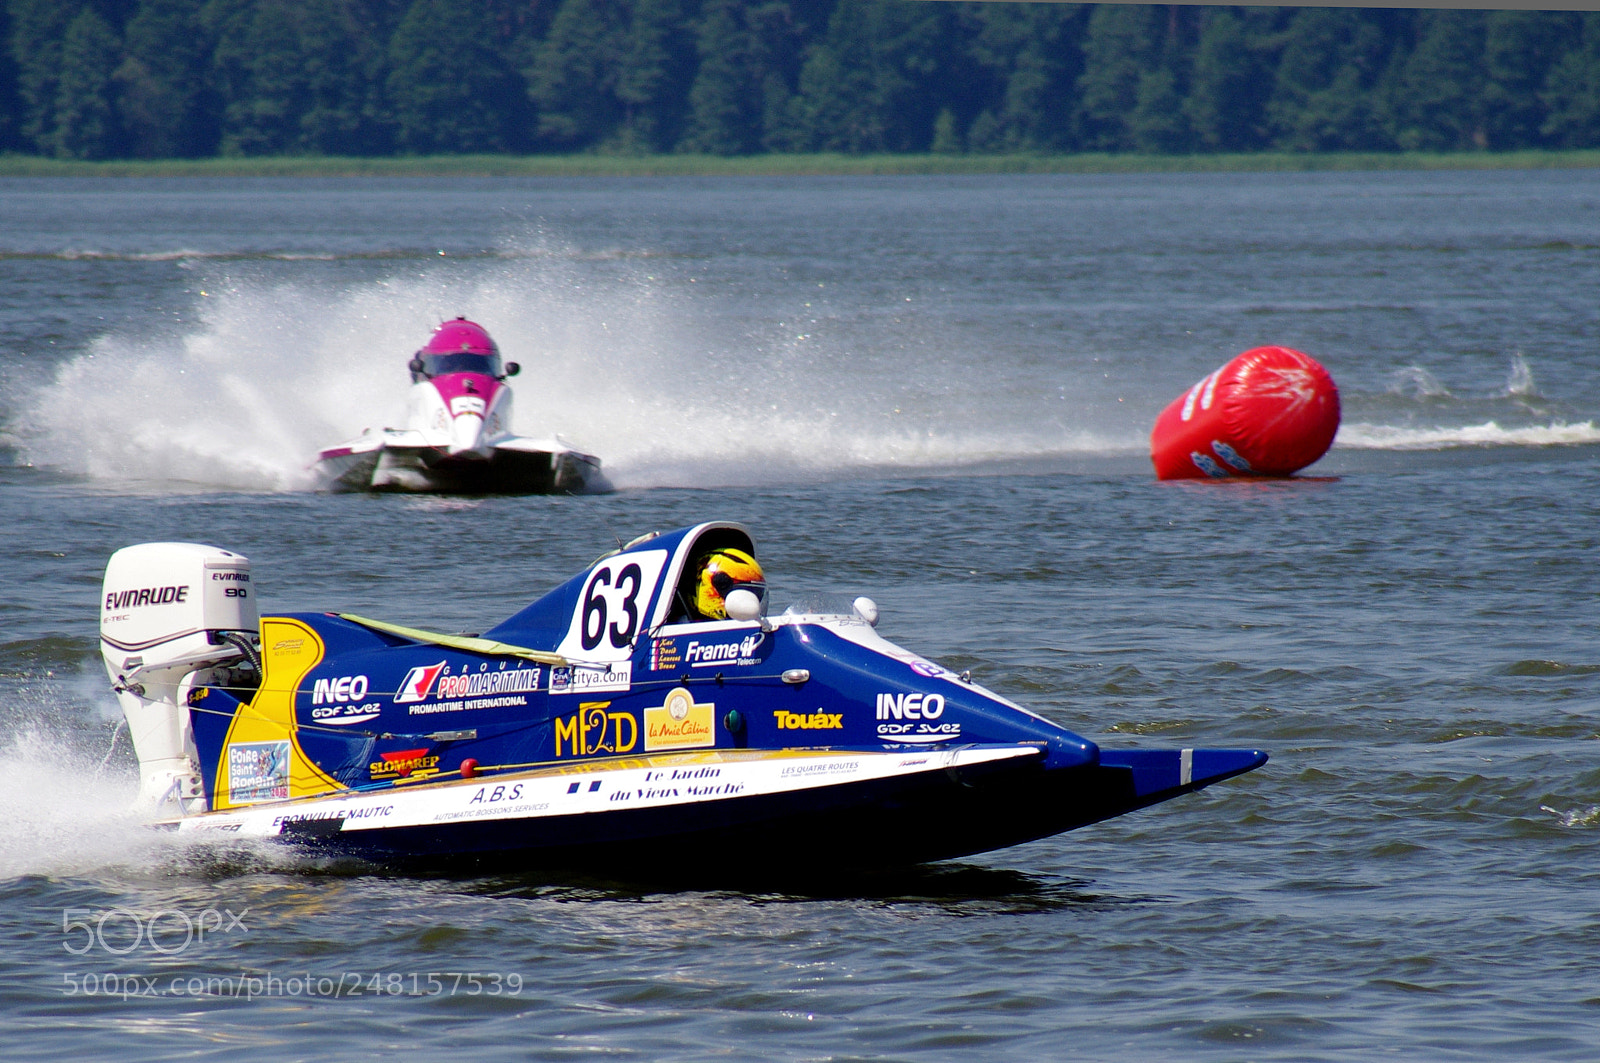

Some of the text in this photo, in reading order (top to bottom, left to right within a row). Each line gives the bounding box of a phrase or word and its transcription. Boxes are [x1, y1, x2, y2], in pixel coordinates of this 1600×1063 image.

[212, 573, 249, 583] EVINRUDE
[106, 585, 189, 611] EVINRUDE
[225, 588, 247, 598] 90
[581, 562, 641, 650] 63
[103, 614, 130, 624] E-TEC
[312, 675, 368, 705] INEO
[437, 668, 541, 699] PROMARITIME
[312, 706, 343, 718] GDF
[409, 695, 527, 716] PROMARITIME INTERNATIONAL
[876, 693, 945, 720] INEO
[877, 723, 914, 734] GDF
[369, 755, 440, 774] SLOMAREP
[796, 763, 827, 774] QUATRE
[828, 761, 859, 771] ROUTES
[469, 783, 524, 804] A.B.S.
[609, 781, 744, 802] du Vieux Marché
[345, 805, 394, 820] NAUTIC
[433, 802, 550, 821] AUTOMATIC BOISSONS SERVICES
